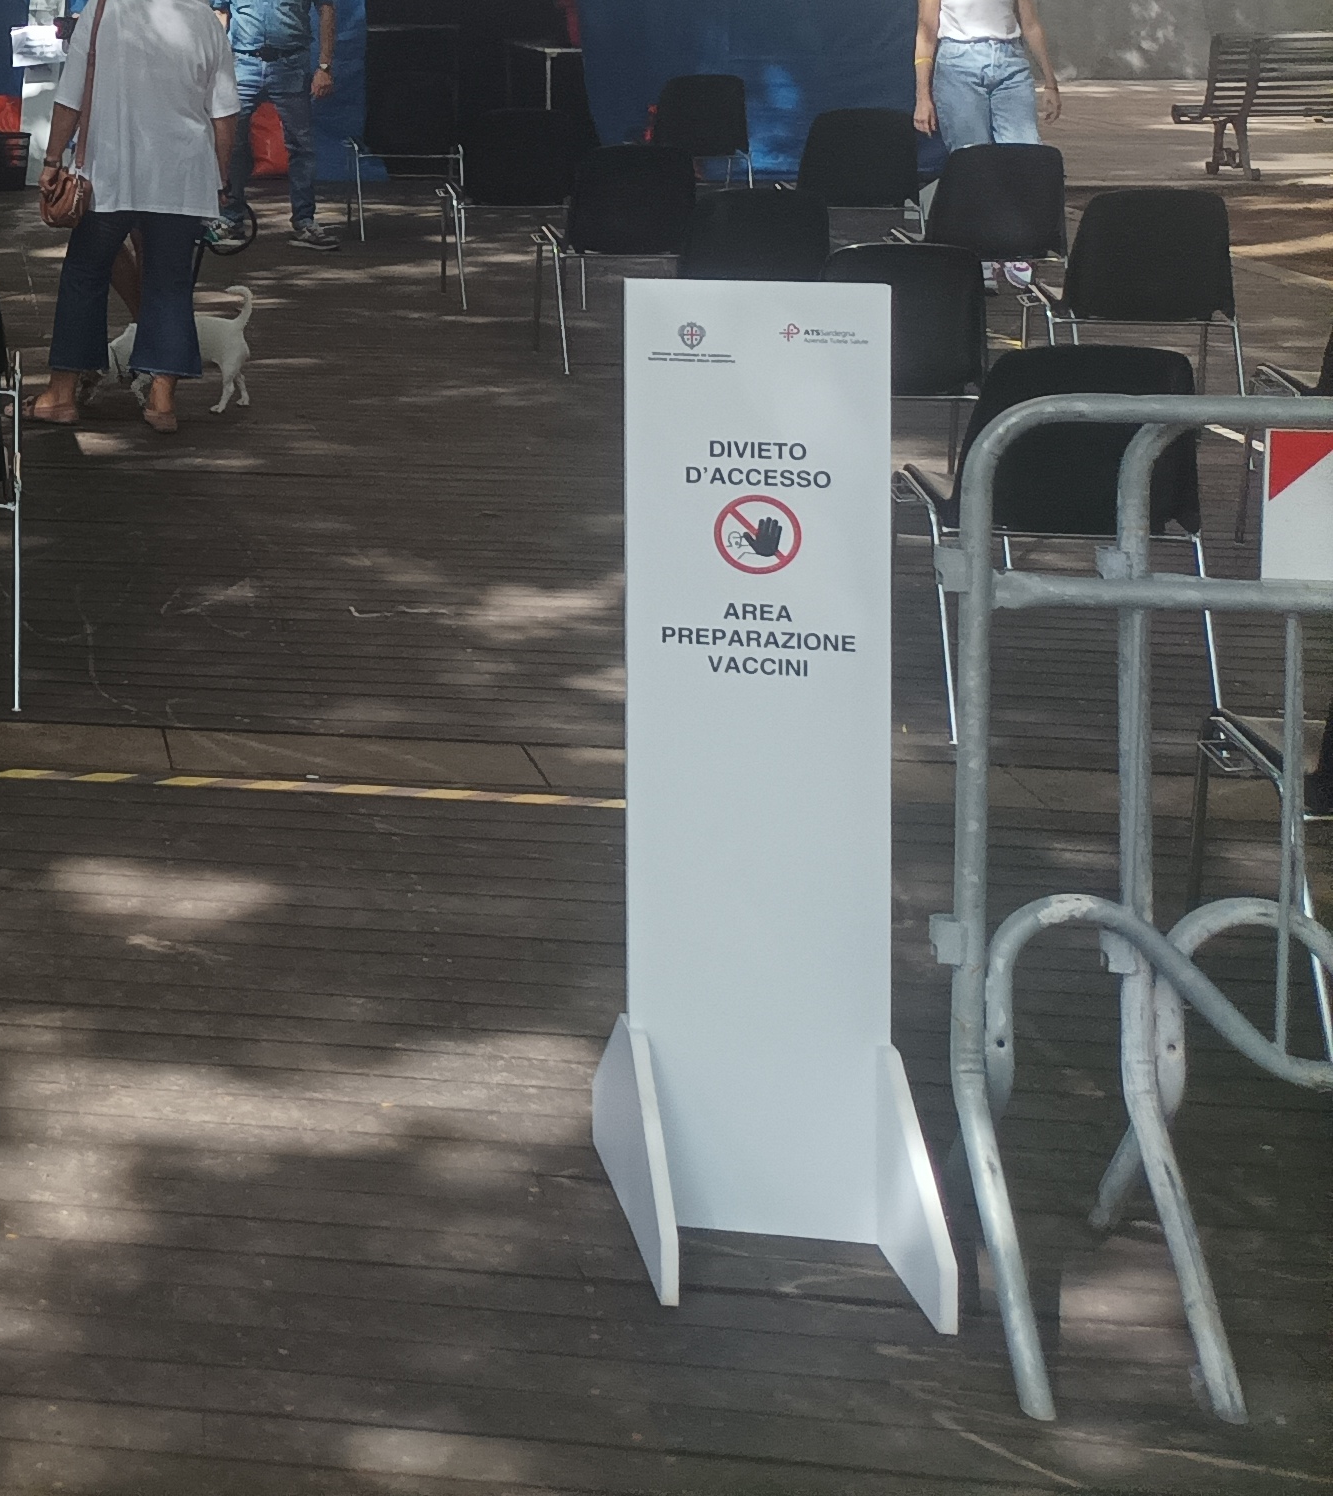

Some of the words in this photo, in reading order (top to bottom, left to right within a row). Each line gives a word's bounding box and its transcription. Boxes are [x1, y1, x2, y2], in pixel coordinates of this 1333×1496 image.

[709, 440, 807, 461] DIVIETO
[723, 602, 793, 623] AREA
[661, 627, 857, 653] PREPARAZIONE
[707, 655, 808, 678] VACCINI
